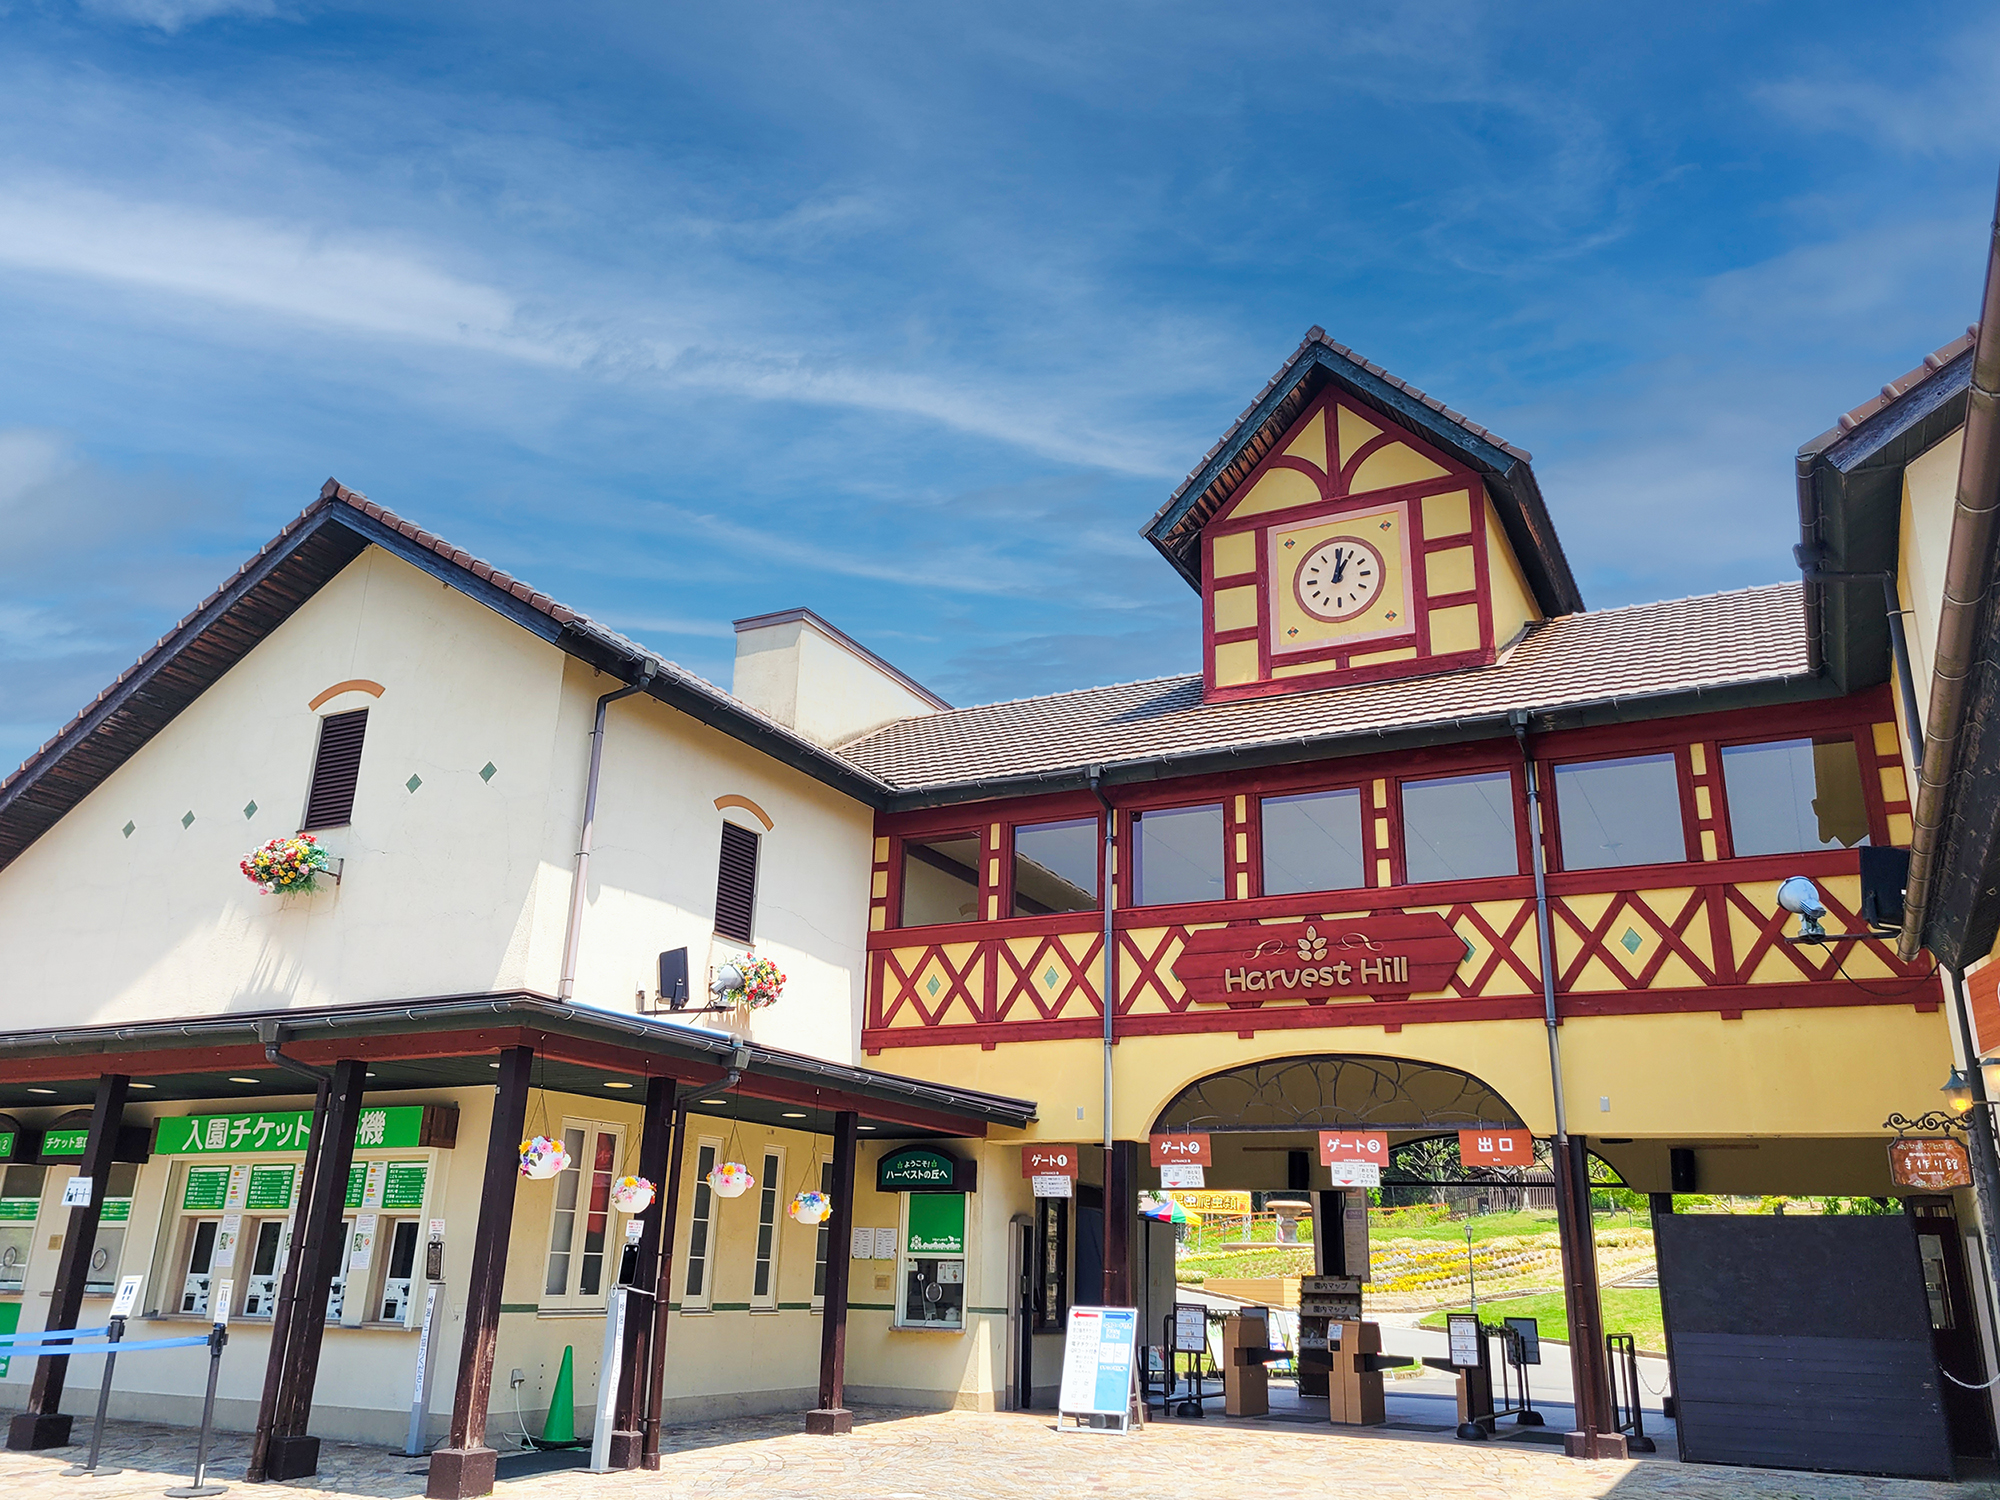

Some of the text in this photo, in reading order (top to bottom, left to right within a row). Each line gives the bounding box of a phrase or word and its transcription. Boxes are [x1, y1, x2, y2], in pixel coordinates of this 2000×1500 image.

[1224, 956, 1409, 993] Harvest Hill
[182, 1111, 386, 1150] 入園チケット機
[1477, 1136, 1513, 1152] 出口
[886, 1169, 948, 1179] ハーベストの丘へ
[1314, 1282, 1348, 1290] 園内マップ
[1313, 1305, 1347, 1313] 園内マップ
